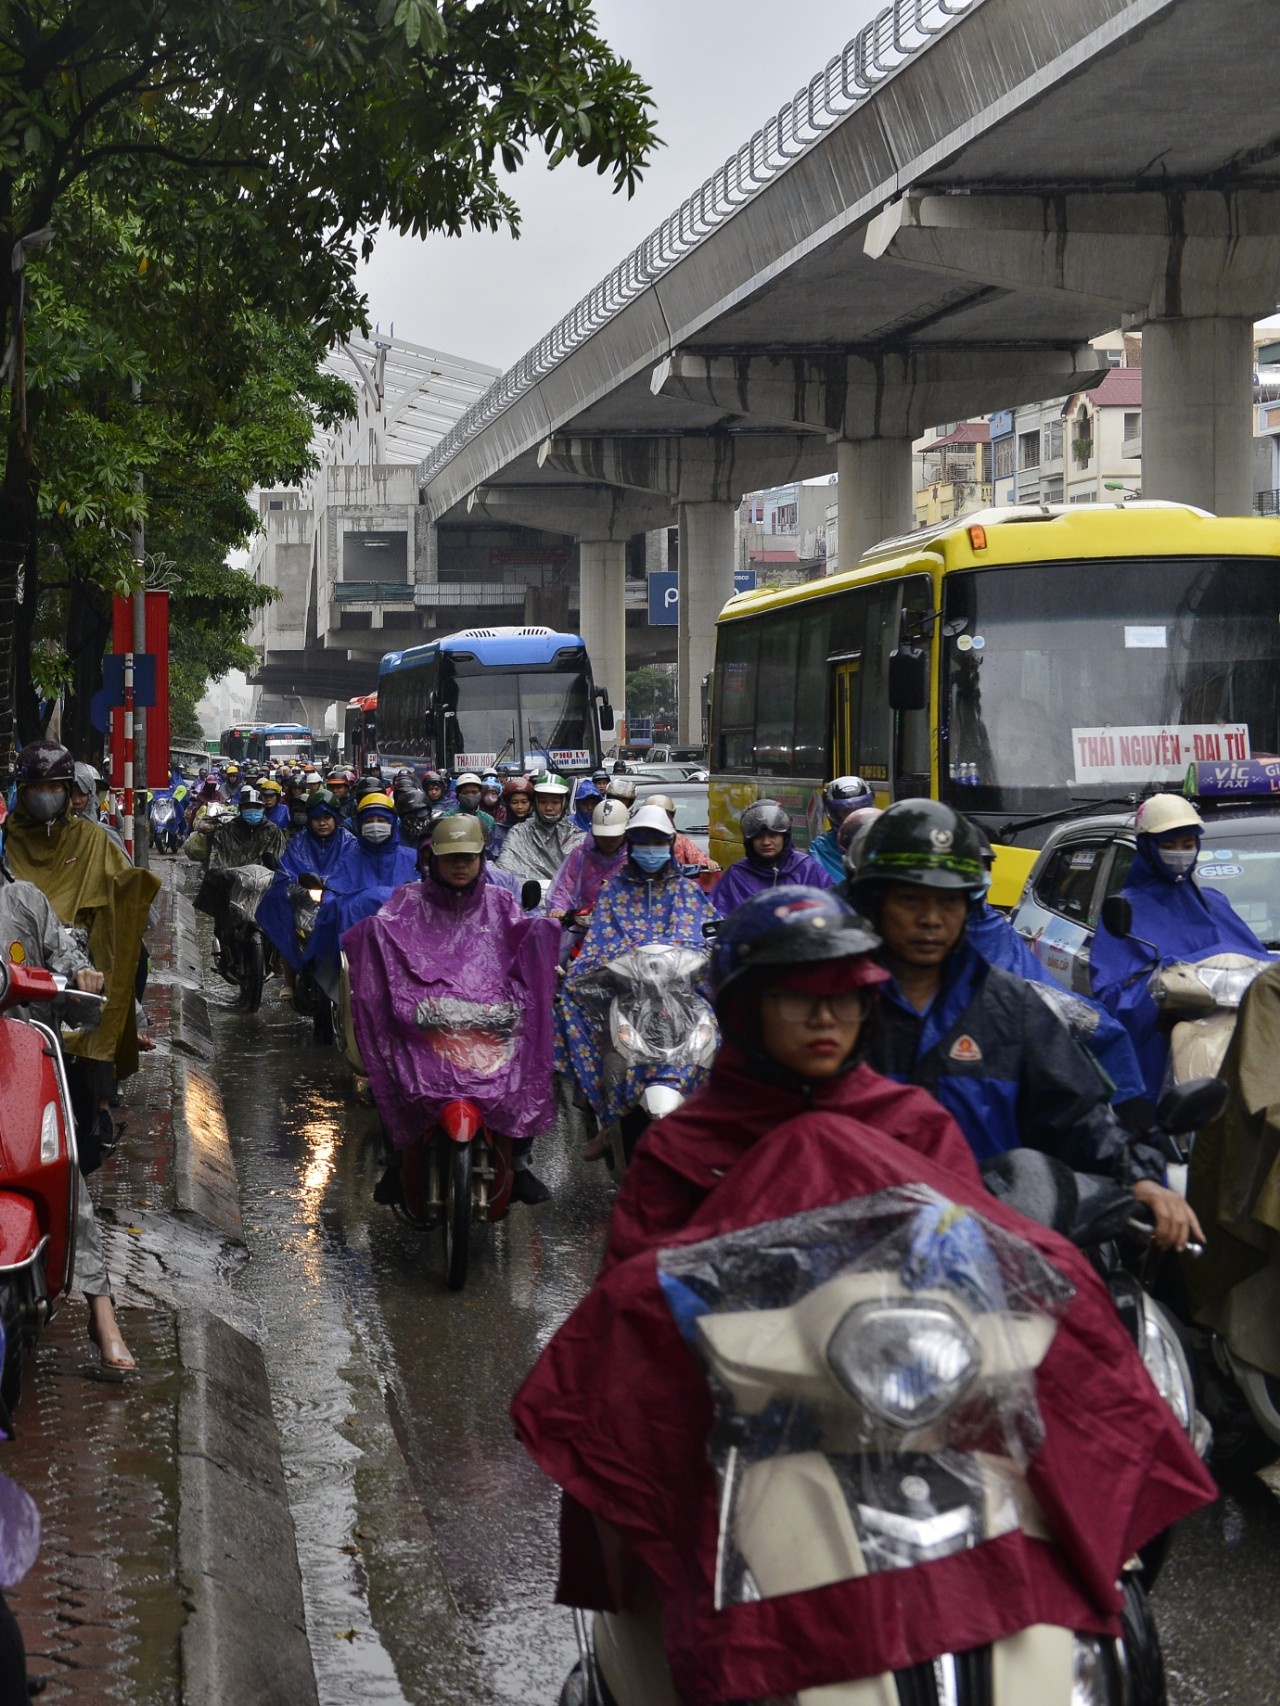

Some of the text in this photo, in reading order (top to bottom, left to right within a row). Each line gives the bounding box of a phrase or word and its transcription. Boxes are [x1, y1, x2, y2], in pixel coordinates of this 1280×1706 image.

[1078, 731, 1116, 768] THÁI
[1119, 730, 1181, 767] NGUYÊN
[1224, 728, 1246, 760] TỪ
[457, 756, 482, 767] THANH
[1217, 780, 1249, 789] TAXI
